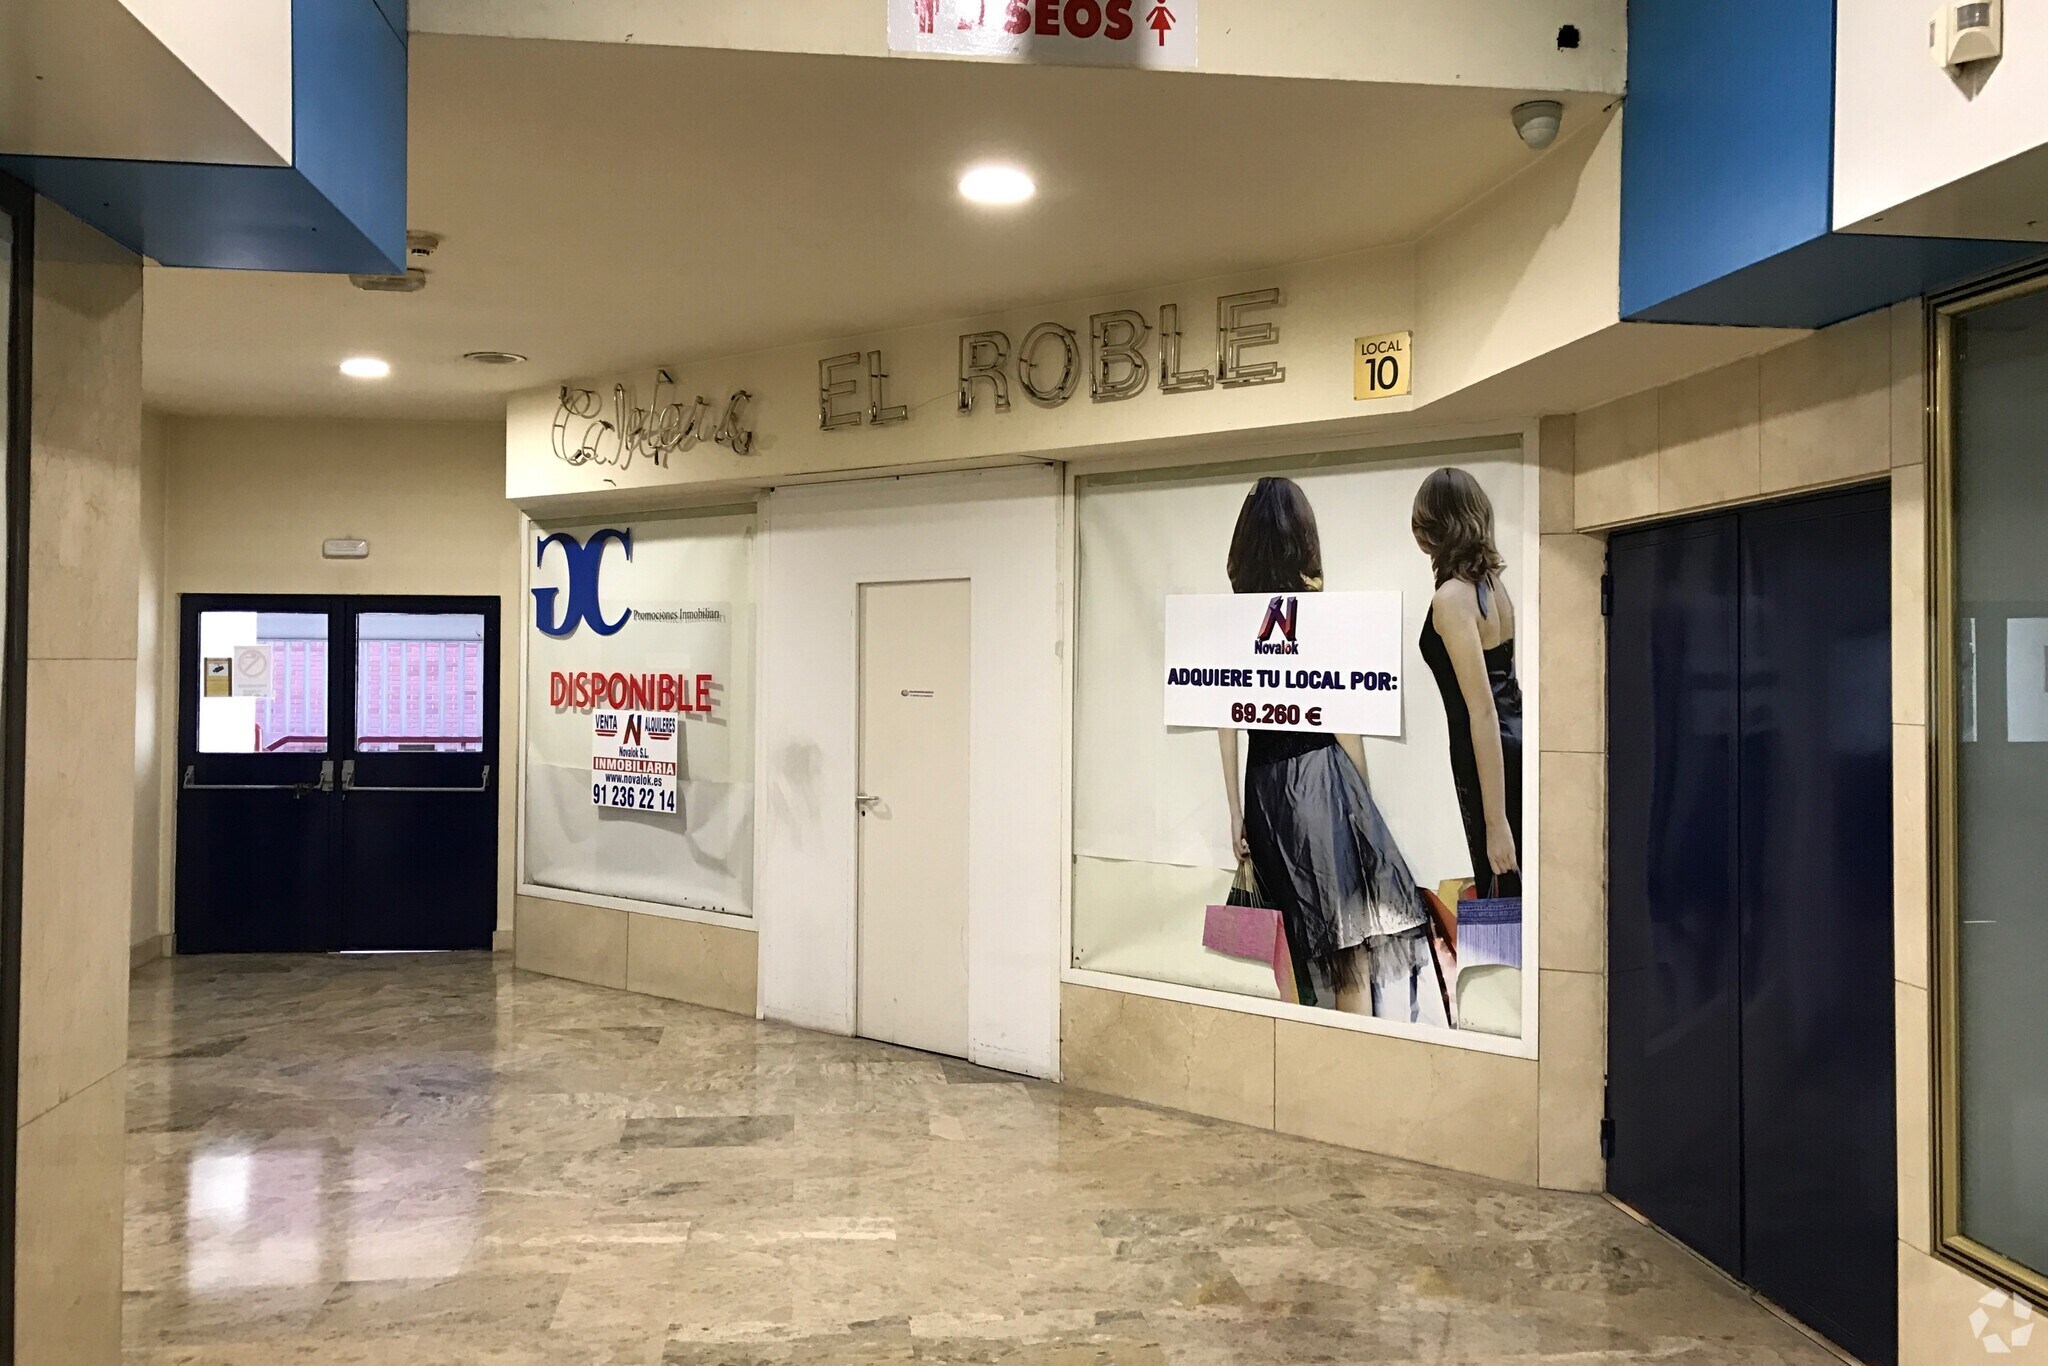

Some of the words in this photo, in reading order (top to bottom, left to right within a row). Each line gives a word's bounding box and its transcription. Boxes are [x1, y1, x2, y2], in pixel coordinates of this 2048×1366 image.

[1361, 339, 1403, 354] LOCAL
[818, 350, 908, 430] EL
[957, 287, 1284, 412] ROBLE
[1365, 354, 1399, 392] 10
[633, 609, 678, 621] Promociones
[1254, 639, 1299, 655] Novalok
[1168, 667, 1253, 687] ADQUIERE
[1257, 669, 1280, 688] TU
[1285, 670, 1345, 690] LOCAL
[1350, 671, 1397, 691] POR:
[550, 671, 712, 711] DISPONIBLE
[595, 714, 617, 730] VENTA
[1231, 702, 1300, 725] 69.260
[1305, 706, 1322, 726] €
[645, 716, 676, 733] ALQUILERES
[618, 746, 639, 758] Novalok
[639, 747, 649, 759] S.L.
[595, 757, 675, 775] INMOBILIARIA
[605, 773, 662, 787] www.novalok.es
[593, 783, 607, 804] 91
[612, 785, 635, 807] 236
[639, 787, 655, 810] 22
[659, 789, 675, 811] 14
